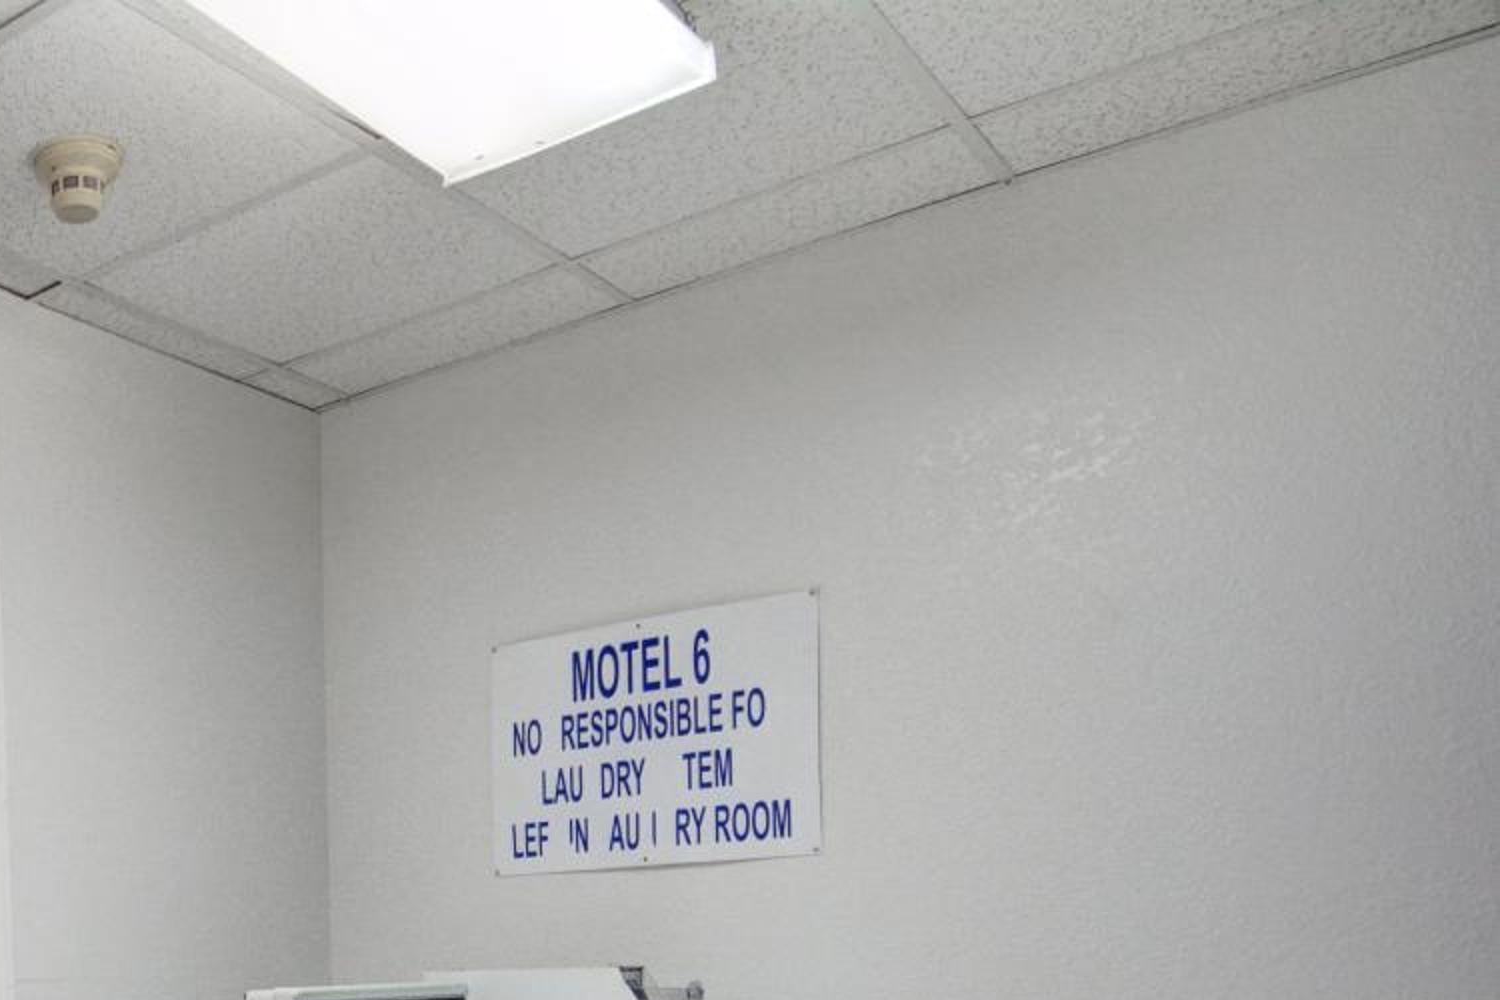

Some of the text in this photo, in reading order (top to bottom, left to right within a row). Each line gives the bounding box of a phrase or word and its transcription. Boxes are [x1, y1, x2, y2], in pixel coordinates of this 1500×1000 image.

[571, 628, 711, 703] MOTEL 6
[512, 687, 766, 758] NO RESPONSIBLE FO
[512, 821, 549, 859] LEF
[714, 799, 793, 844] ROOM
